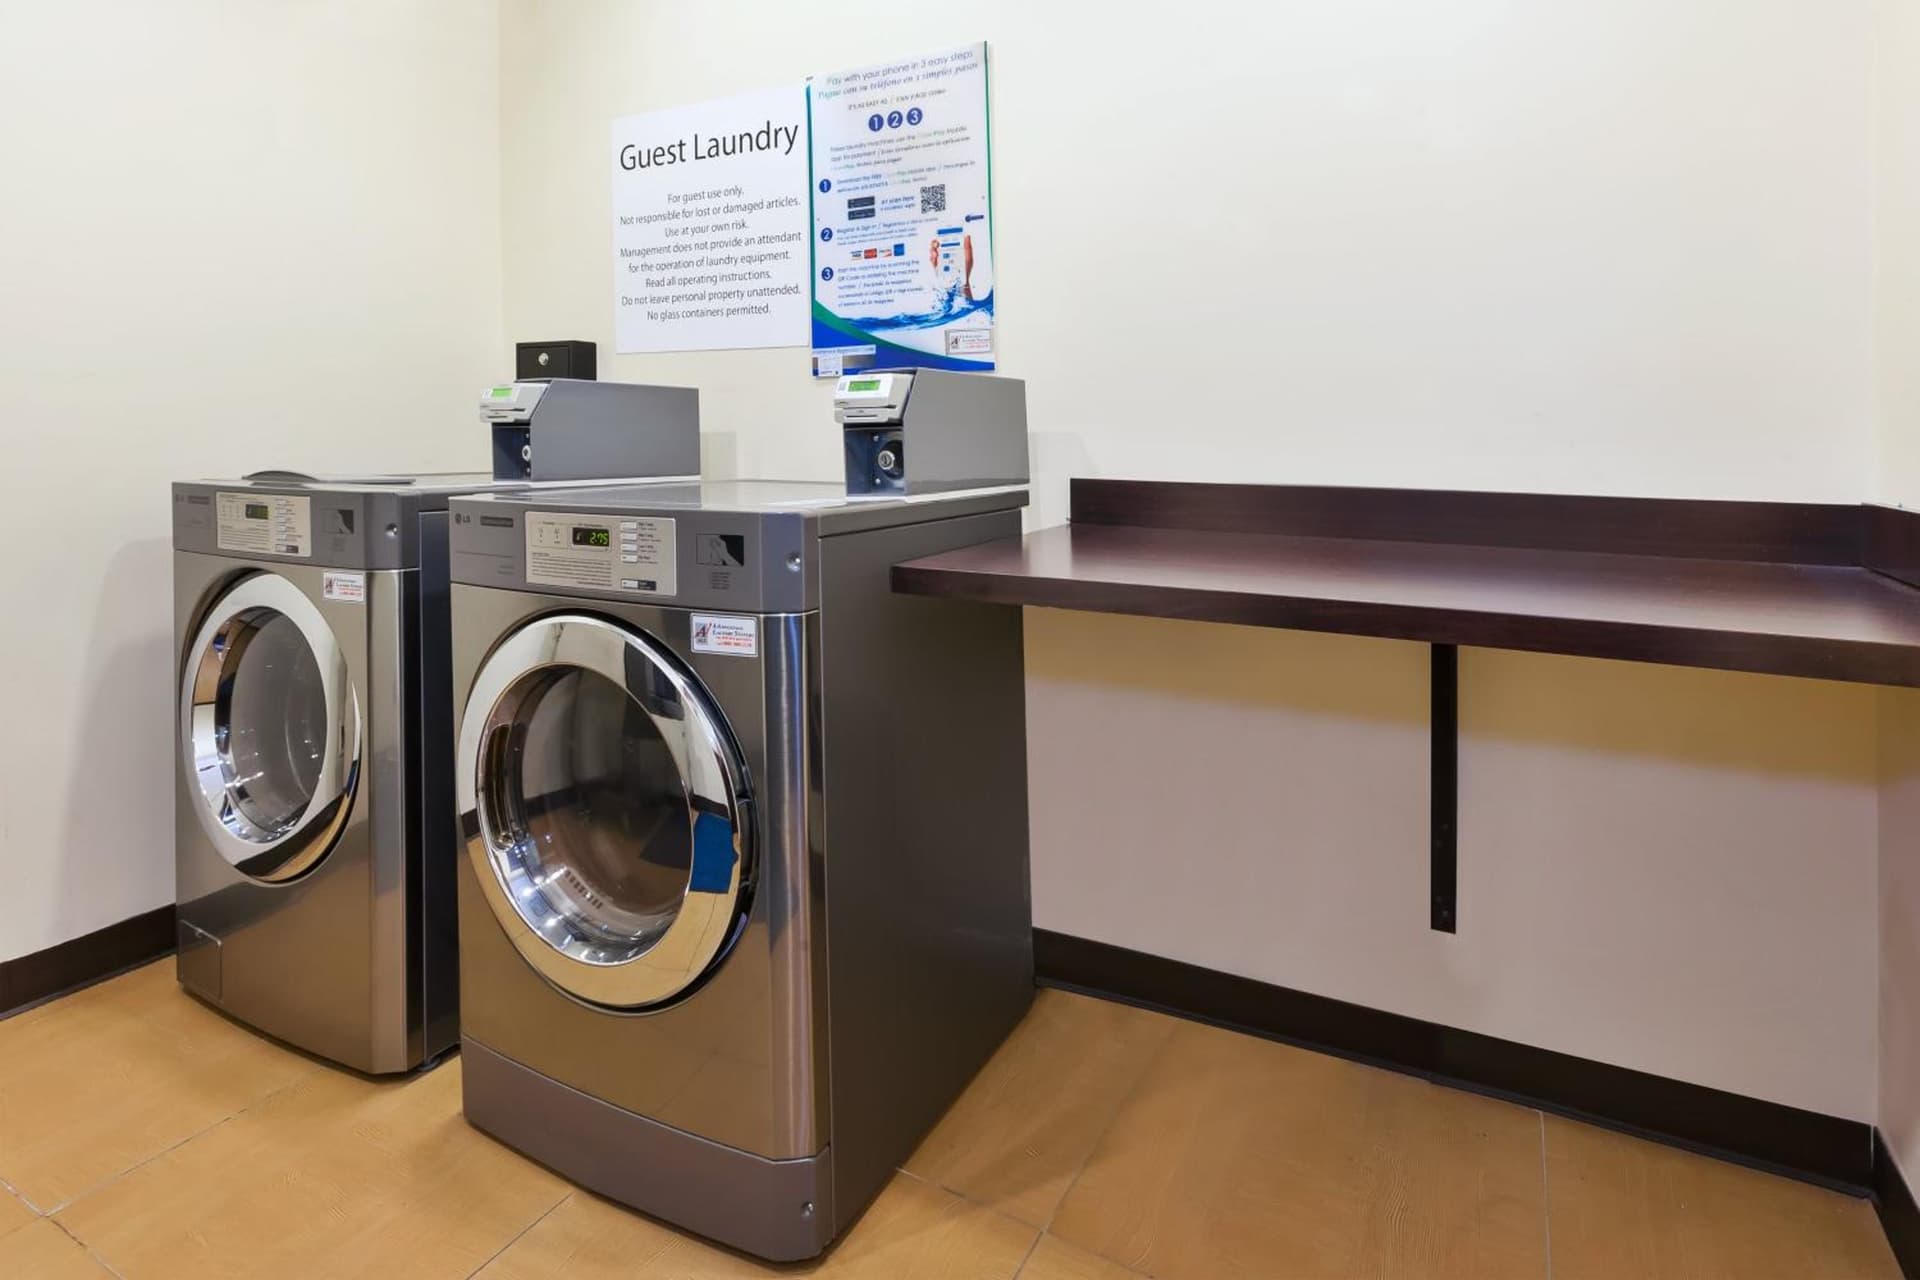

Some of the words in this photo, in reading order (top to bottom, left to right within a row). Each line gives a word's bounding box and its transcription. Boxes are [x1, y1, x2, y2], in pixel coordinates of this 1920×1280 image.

[844, 73, 861, 82] with
[862, 71, 880, 81] your
[882, 64, 910, 76] phone
[911, 62, 919, 70] in
[921, 59, 927, 69] 3
[928, 57, 949, 67] easy
[950, 50, 974, 62] steps
[620, 139, 686, 171] Guest
[694, 120, 799, 160] Laundry
[667, 194, 680, 204] For
[682, 190, 705, 205] guest
[707, 189, 721, 199] use
[723, 185, 744, 198] only.
[619, 215, 635, 225] Not
[635, 209, 681, 225] responsible
[681, 207, 694, 219] for
[696, 206, 711, 217] lost
[712, 206, 722, 216] or
[723, 198, 764, 214] damaged
[766, 195, 801, 210] articles.
[664, 226, 680, 238] Use
[681, 226, 689, 236] at
[691, 224, 710, 237] your
[711, 223, 730, 233] own
[732, 218, 749, 230] risk.
[619, 245, 671, 258] Management
[672, 243, 693, 254] does
[695, 240, 709, 251] not
[710, 236, 743, 251] provide
[744, 237, 756, 246] an
[757, 231, 801, 245] attendant
[628, 262, 639, 273] for
[640, 262, 654, 272] the
[655, 259, 695, 272] operation
[696, 256, 705, 267] of
[706, 254, 738, 266] laundry
[740, 250, 792, 265] equipment.
[645, 277, 666, 288] Read
[666, 276, 676, 286] all
[677, 274, 717, 287] operating
[719, 270, 771, 282] instructions.
[621, 296, 633, 306] Do
[634, 296, 648, 305] not
[649, 294, 670, 304] leave
[671, 290, 706, 304] personal
[708, 288, 745, 301] property
[747, 283, 800, 297] unattended.
[647, 311, 658, 321] No
[659, 307, 681, 322] glass
[681, 307, 724, 319] containers
[726, 303, 771, 317] permitted.
